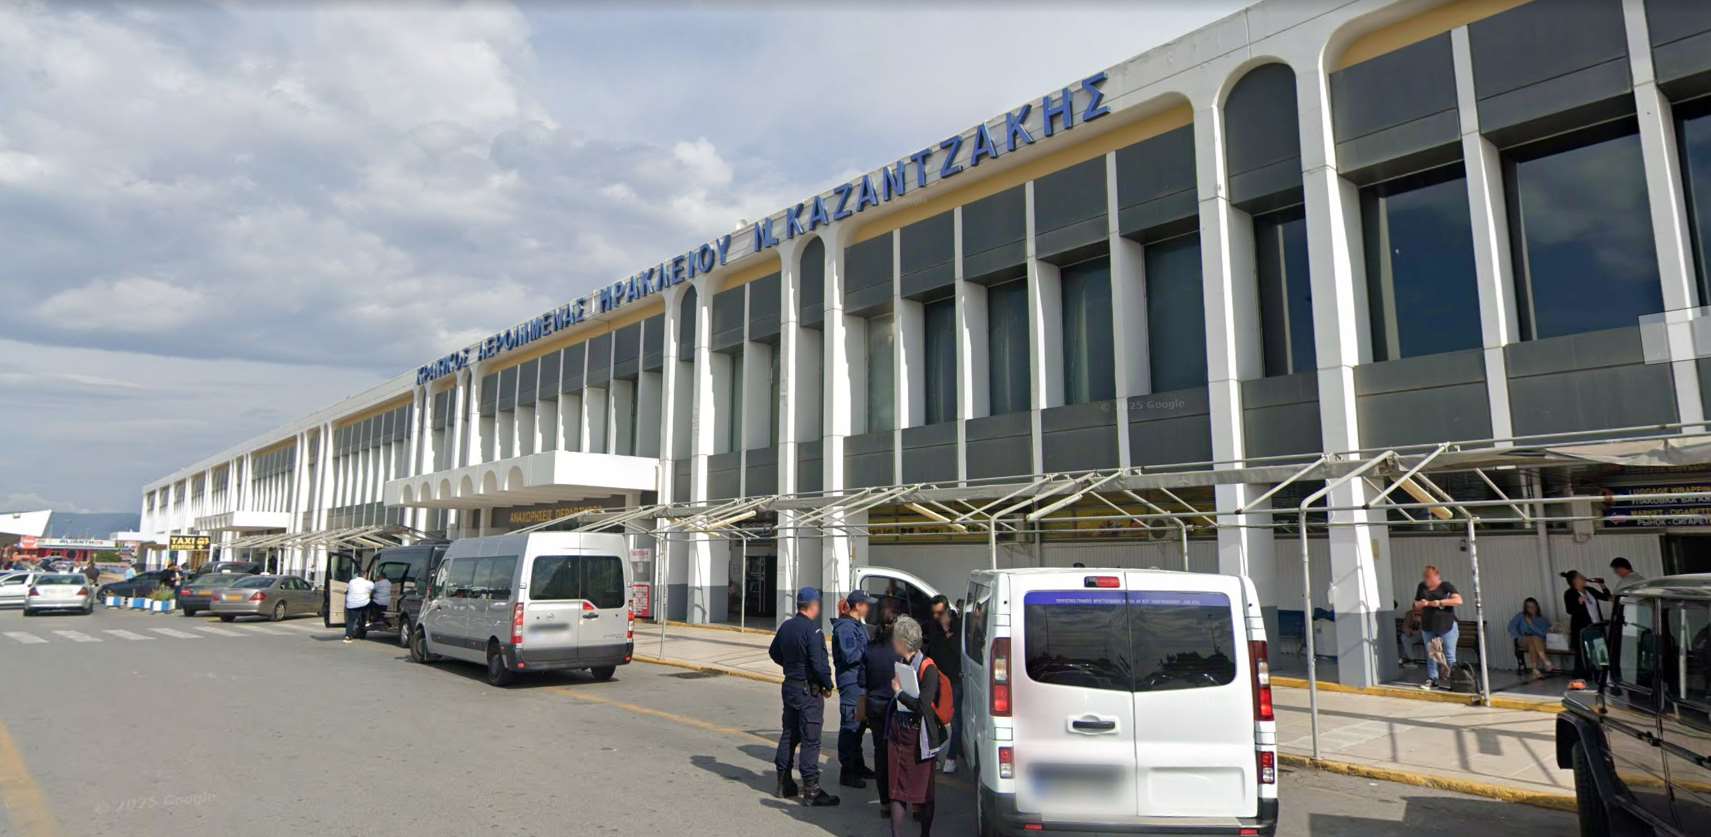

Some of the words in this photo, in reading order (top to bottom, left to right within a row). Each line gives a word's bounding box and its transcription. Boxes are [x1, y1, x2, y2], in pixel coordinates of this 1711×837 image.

[416, 347, 471, 386] ΚΡΑΤΙΚΟΣ
[478, 297, 587, 362] ΑΕΡΟΛΙΜΕΝΑΣ
[600, 234, 732, 313] ΗΡΑΚΛΕΙΟΥ
[786, 71, 1112, 240] ΚΑΖΑΝΤΖΑΚΗΣ
[171, 536, 196, 545] TAXI
